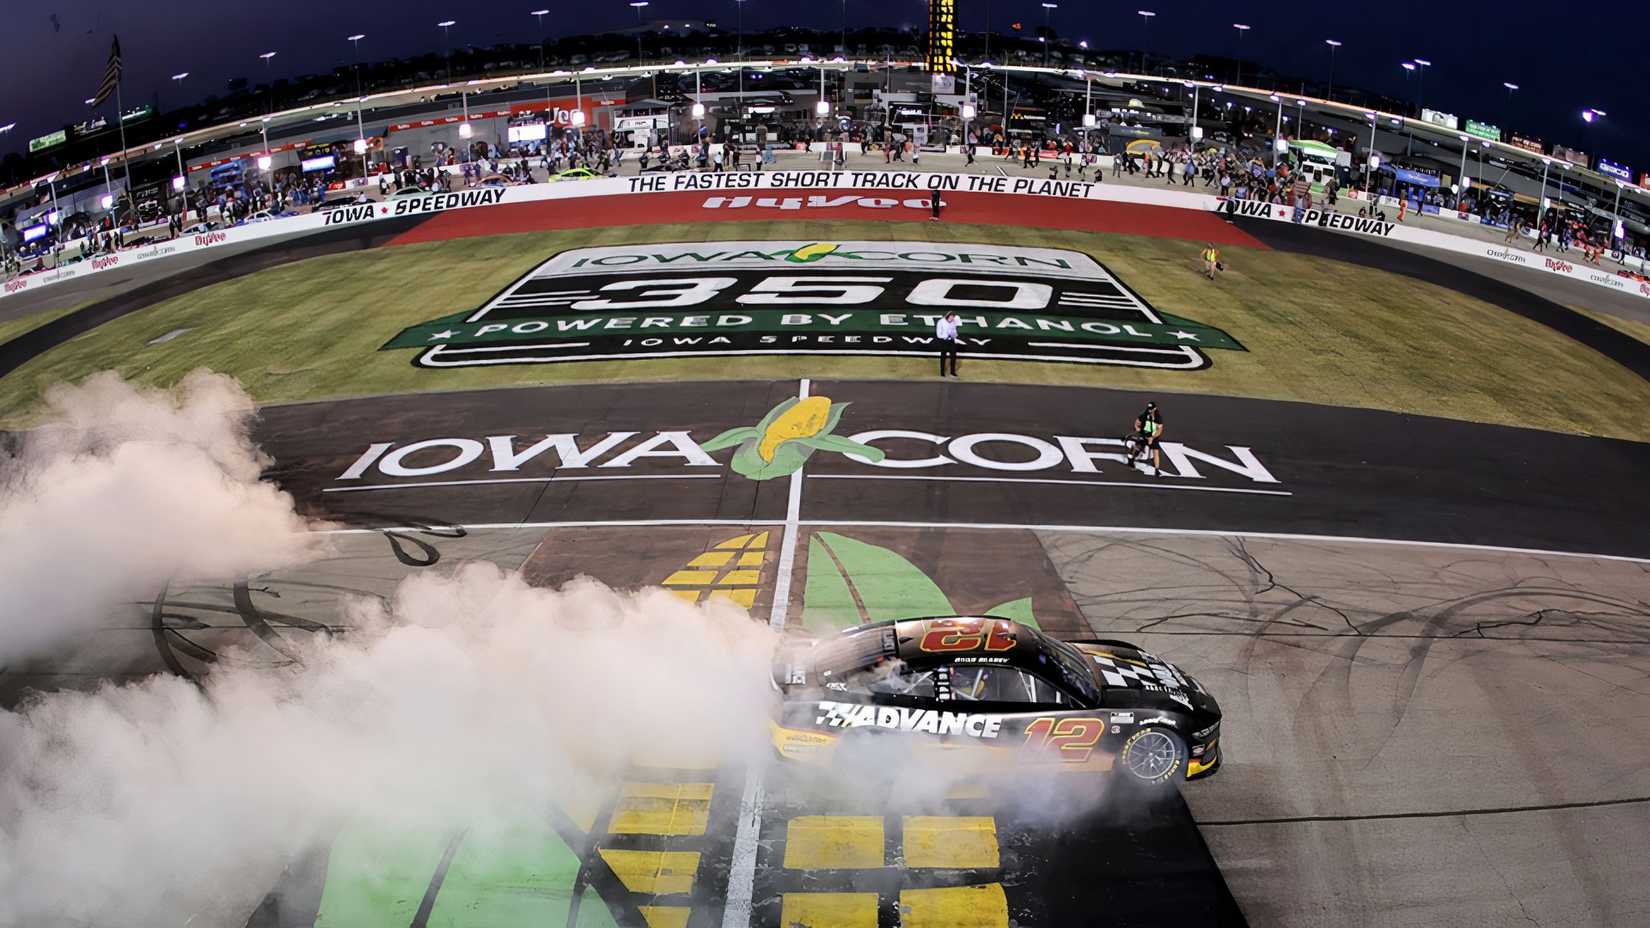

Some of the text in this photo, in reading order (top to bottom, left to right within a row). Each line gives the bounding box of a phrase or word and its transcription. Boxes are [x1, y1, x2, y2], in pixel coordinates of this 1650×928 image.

[628, 172, 1095, 198] THE FASTEST SHORT TRACK ON THE PLANET
[321, 188, 507, 225] IOWA SPEEDWAY
[1300, 206, 1395, 236] PEDWAY
[570, 250, 1073, 270] IOWA CORN
[571, 276, 1054, 311] 350
[473, 312, 1154, 338] POWERED BY ETHANOL
[623, 337, 732, 347] IOWA
[334, 429, 1283, 484] IOWA CORN
[849, 703, 1001, 739] ADVANCE
[1021, 717, 1105, 763] 12
